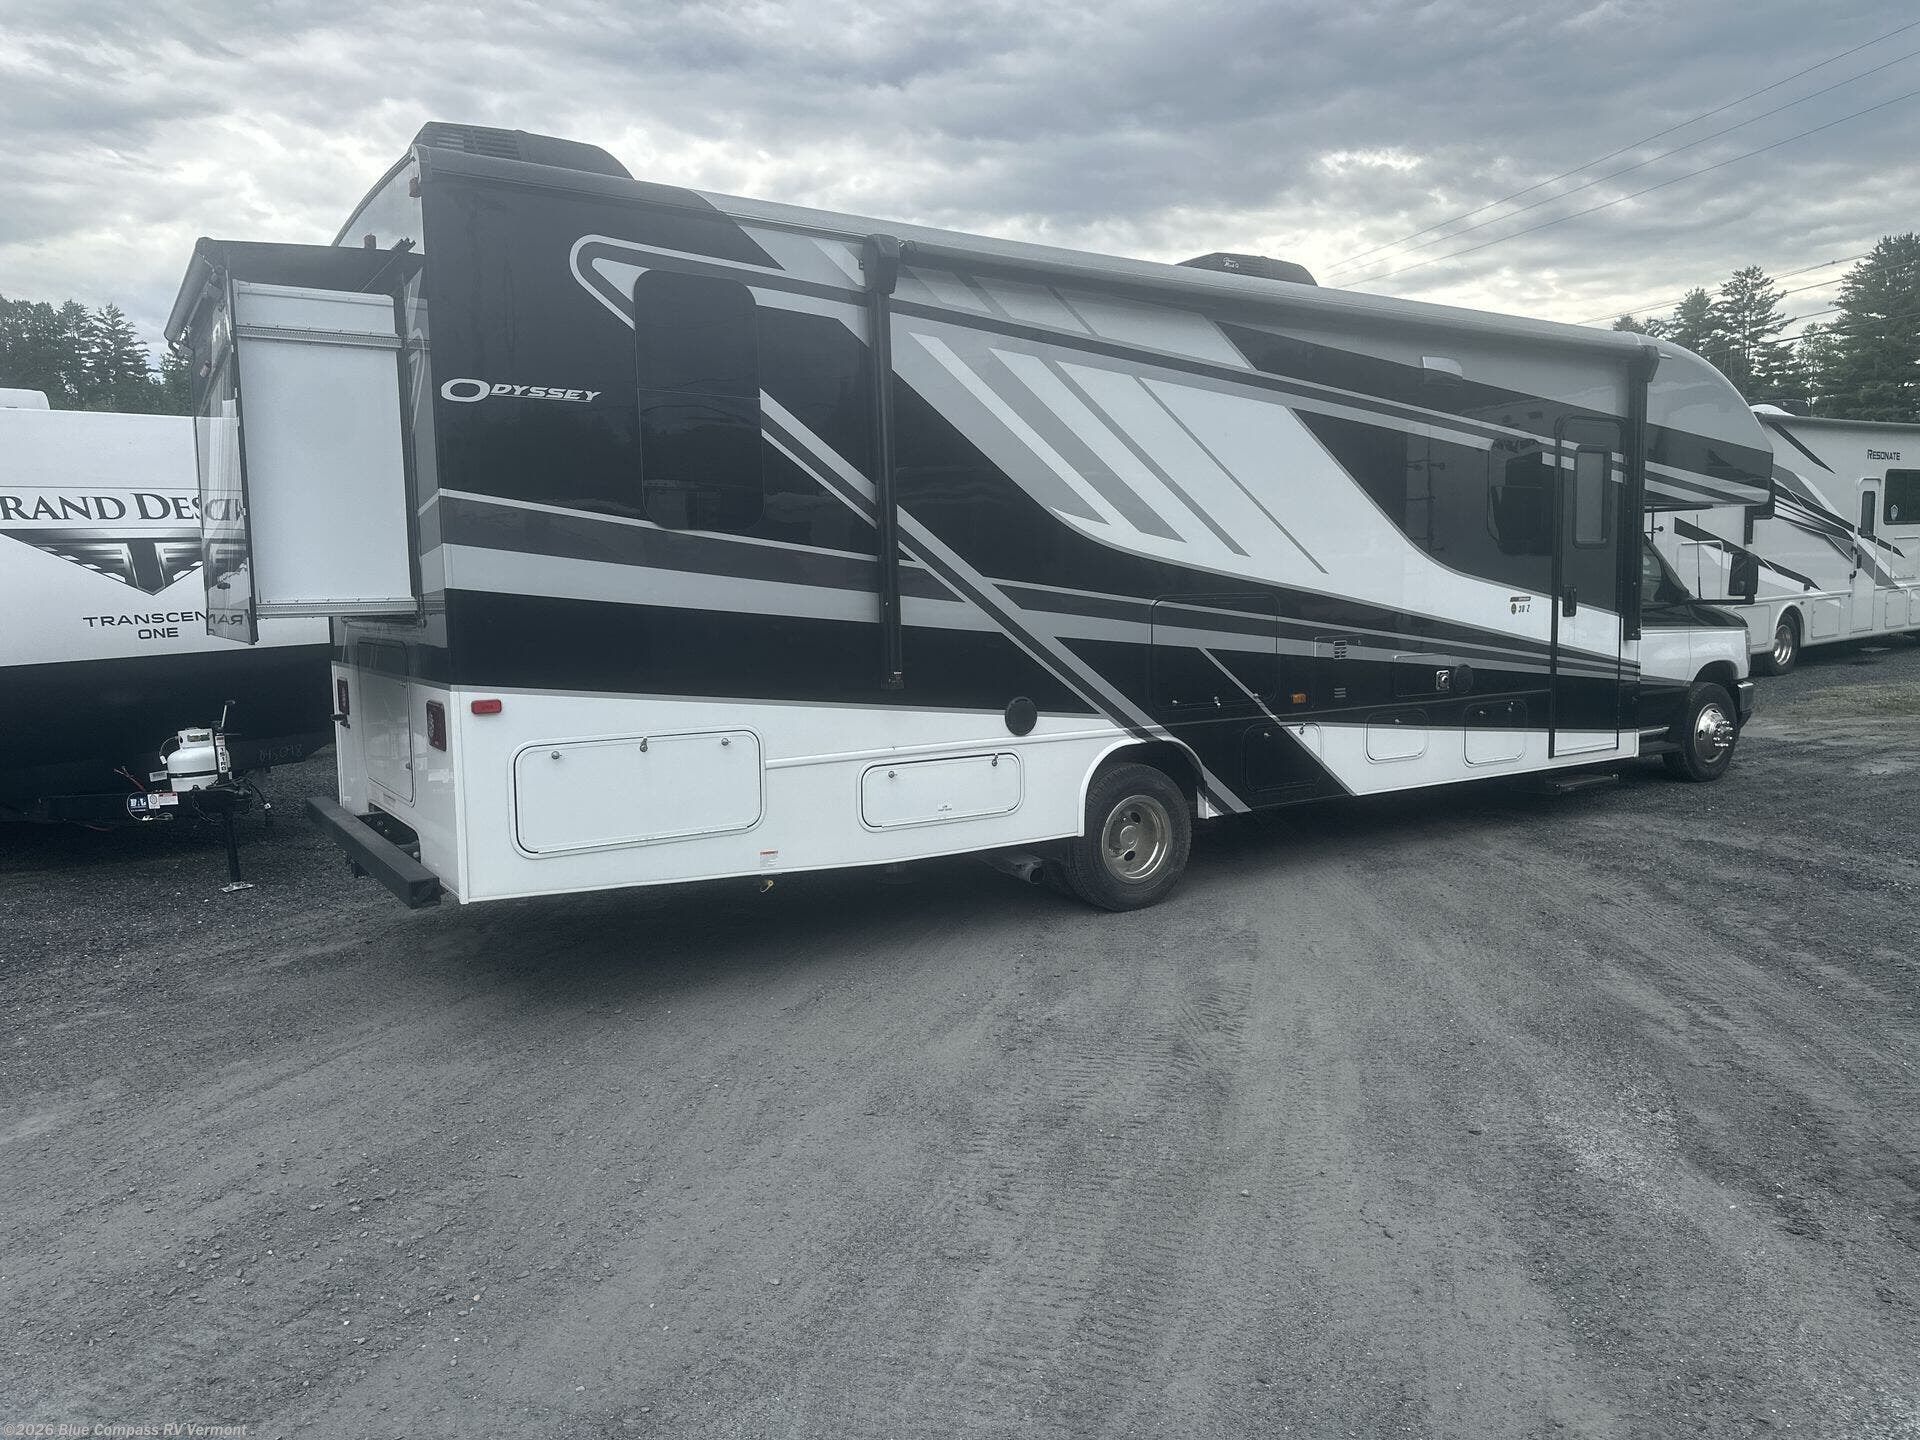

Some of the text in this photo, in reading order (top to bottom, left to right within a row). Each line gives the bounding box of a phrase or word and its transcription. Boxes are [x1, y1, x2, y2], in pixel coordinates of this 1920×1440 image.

[0, 496, 126, 520] RAND
[82, 611, 207, 628] TRANSCEN
[137, 627, 179, 640] ONE
